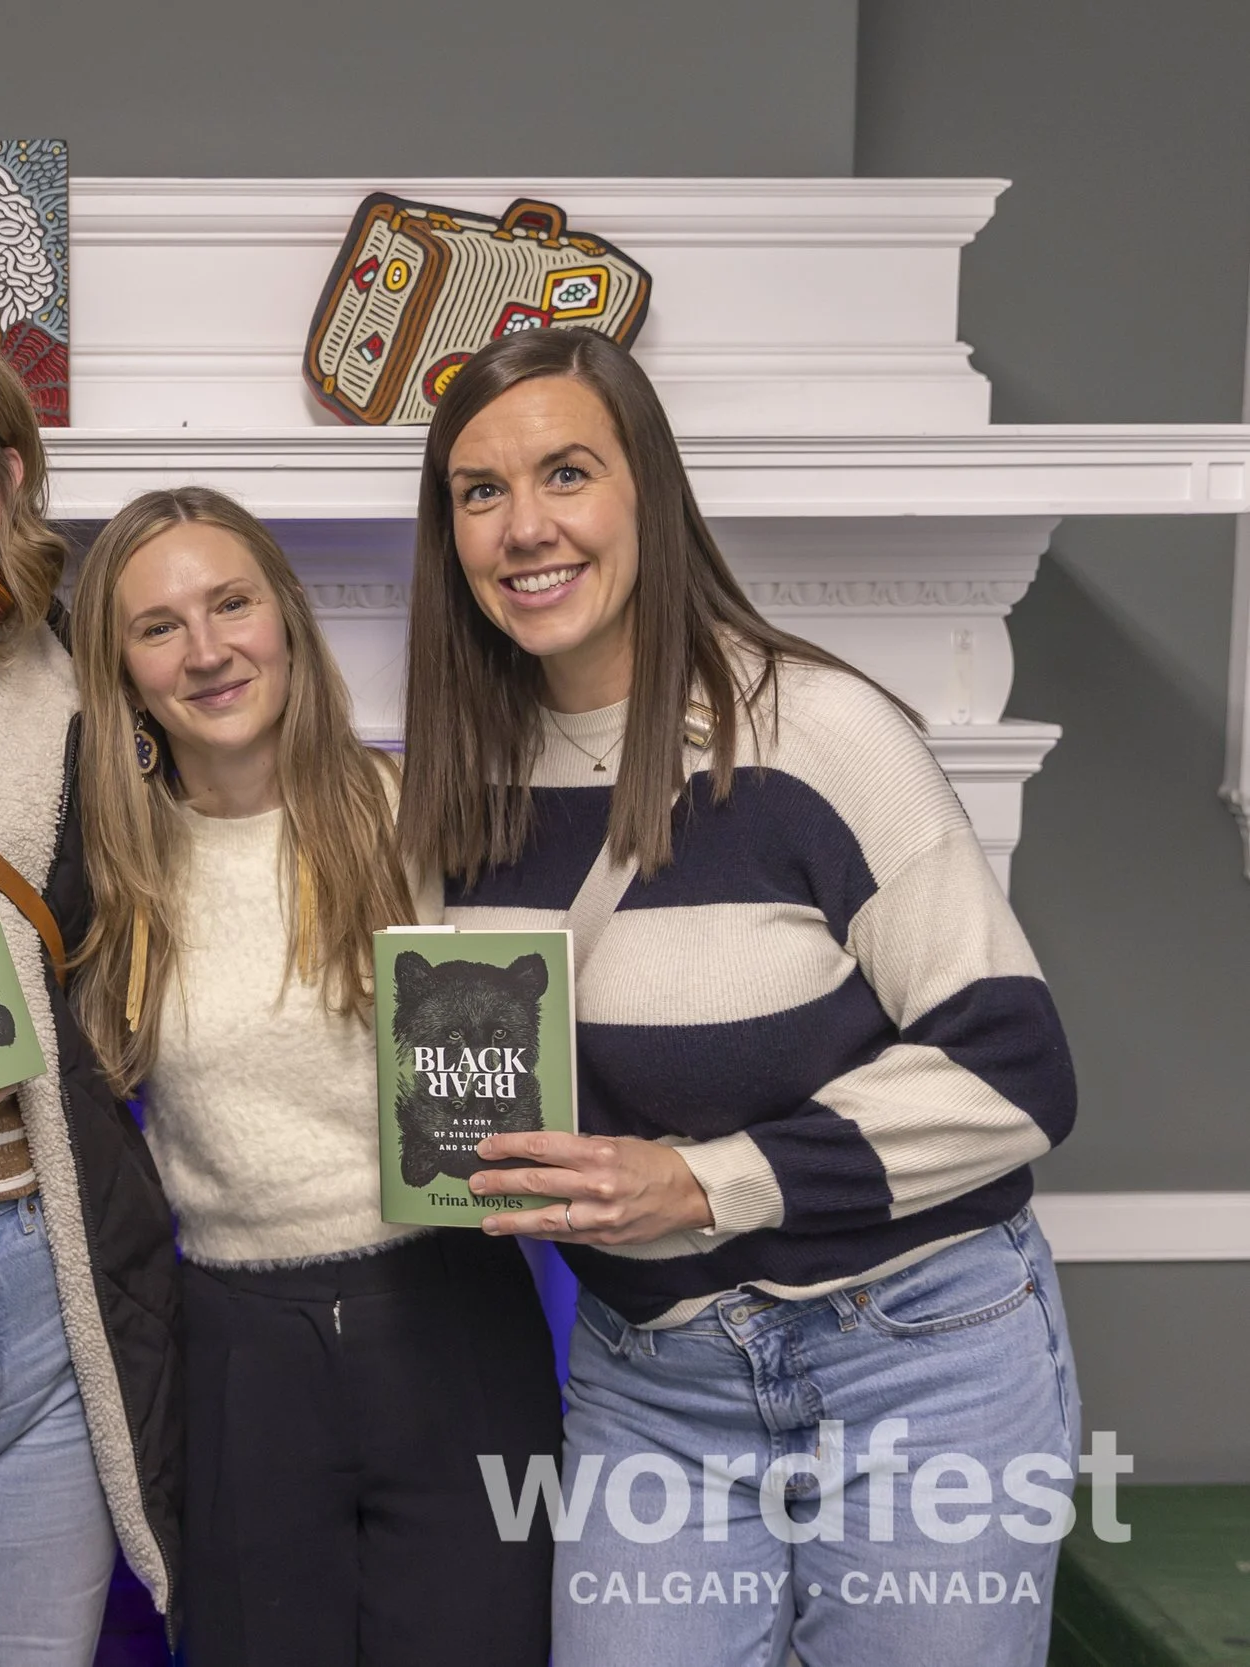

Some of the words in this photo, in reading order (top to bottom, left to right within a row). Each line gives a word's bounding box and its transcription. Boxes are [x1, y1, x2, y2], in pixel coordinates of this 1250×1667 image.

[413, 1046, 529, 1073] BLACK
[425, 1072, 517, 1099] BEAR
[452, 1118, 459, 1126] A
[449, 1131, 499, 1139] SIBLINGH
[427, 1193, 469, 1207] Trina
[472, 1194, 524, 1211] Moyles
